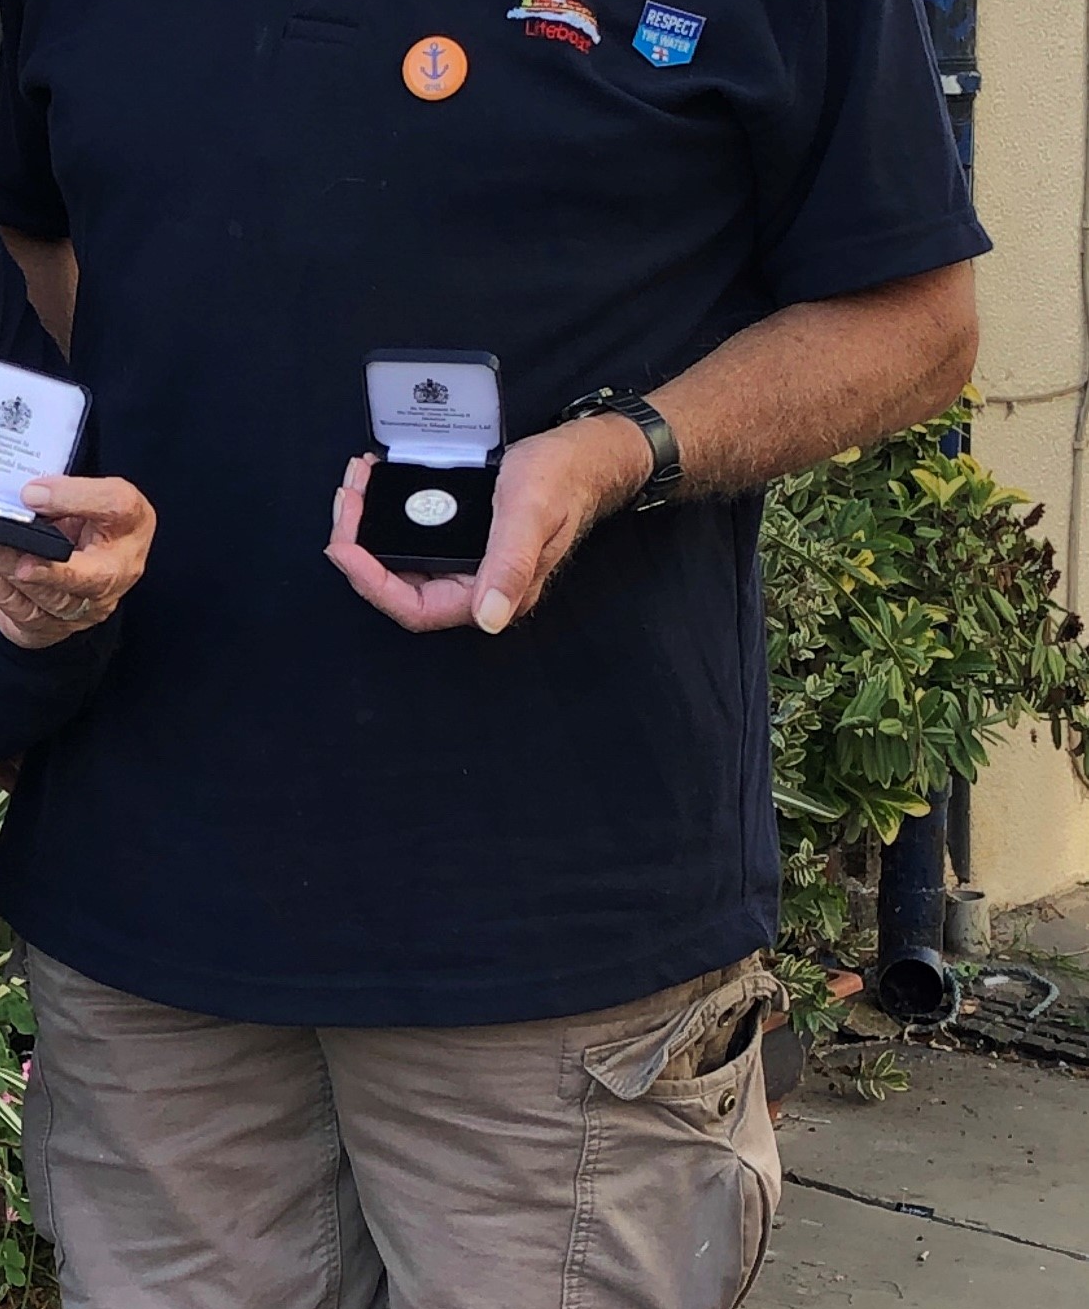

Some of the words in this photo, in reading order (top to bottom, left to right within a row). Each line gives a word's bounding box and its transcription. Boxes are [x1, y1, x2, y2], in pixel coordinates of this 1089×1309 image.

[646, 9, 698, 37] RESPECT
[641, 28, 660, 45] THE
[660, 35, 690, 54] WATER
